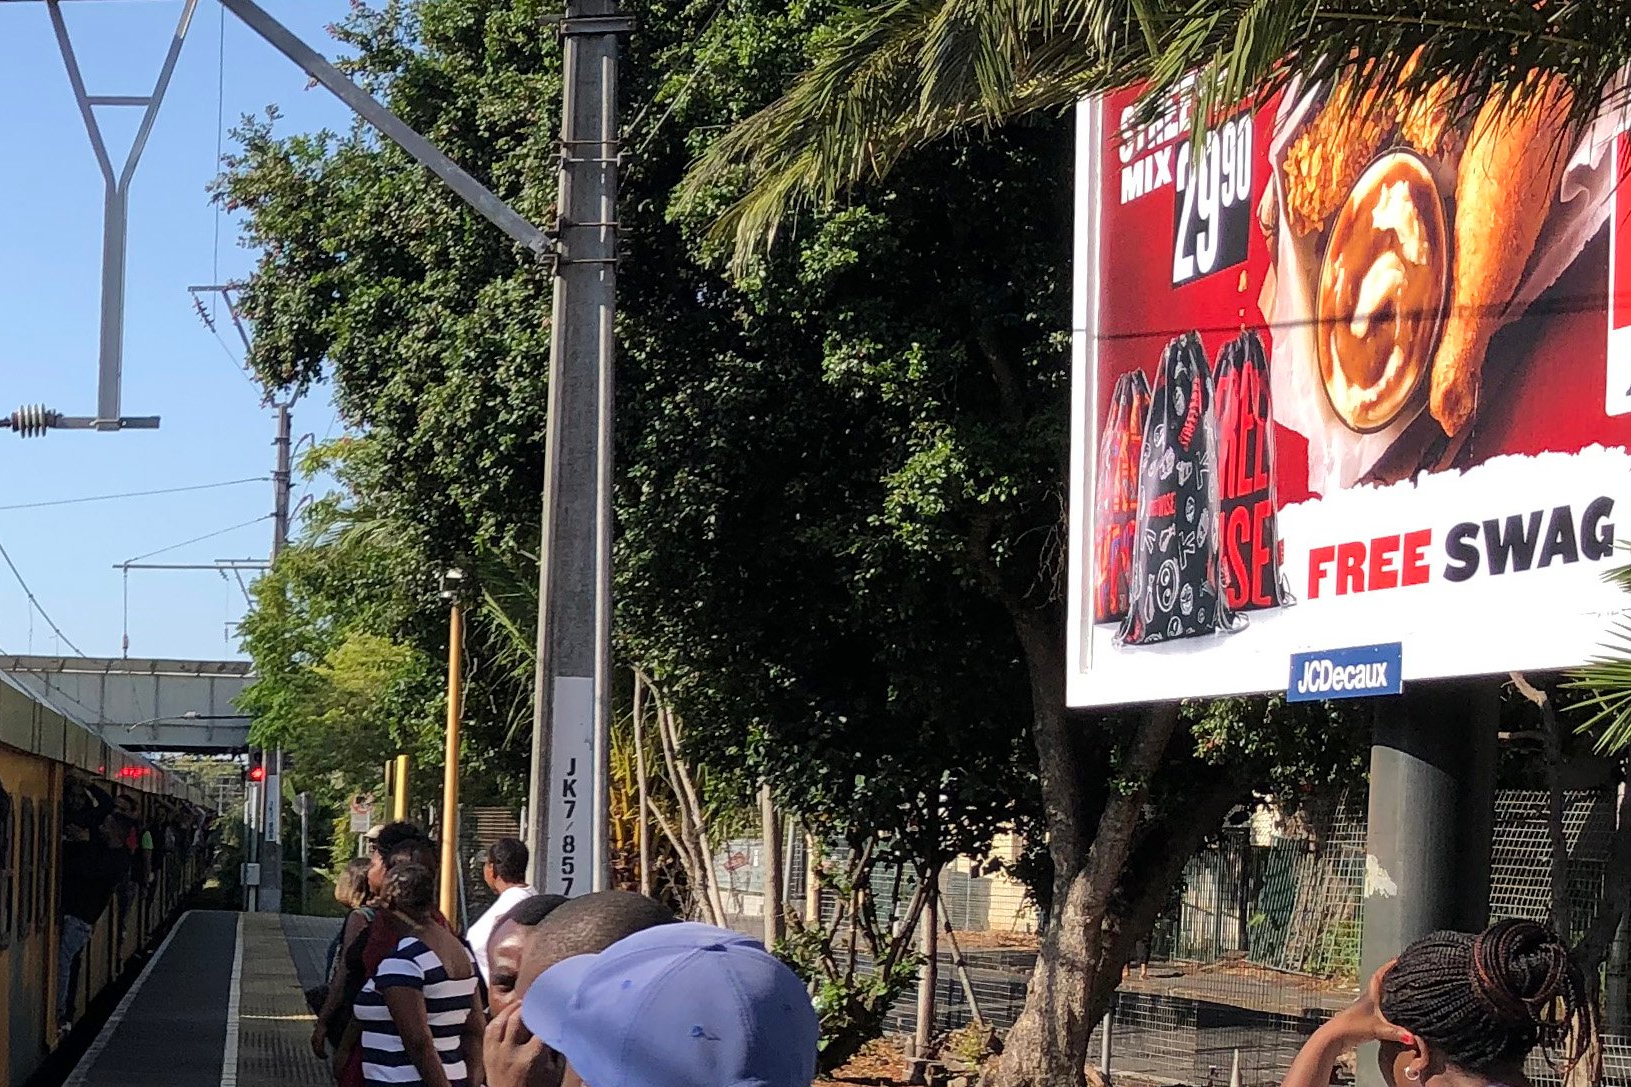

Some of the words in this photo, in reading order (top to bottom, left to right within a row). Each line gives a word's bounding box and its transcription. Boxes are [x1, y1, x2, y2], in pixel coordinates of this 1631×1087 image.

[1120, 144, 1173, 206] MIX
[1307, 528, 1433, 600] FREE
[1443, 496, 1616, 583] SWAG
[1297, 659, 1388, 694] JCDecaux
